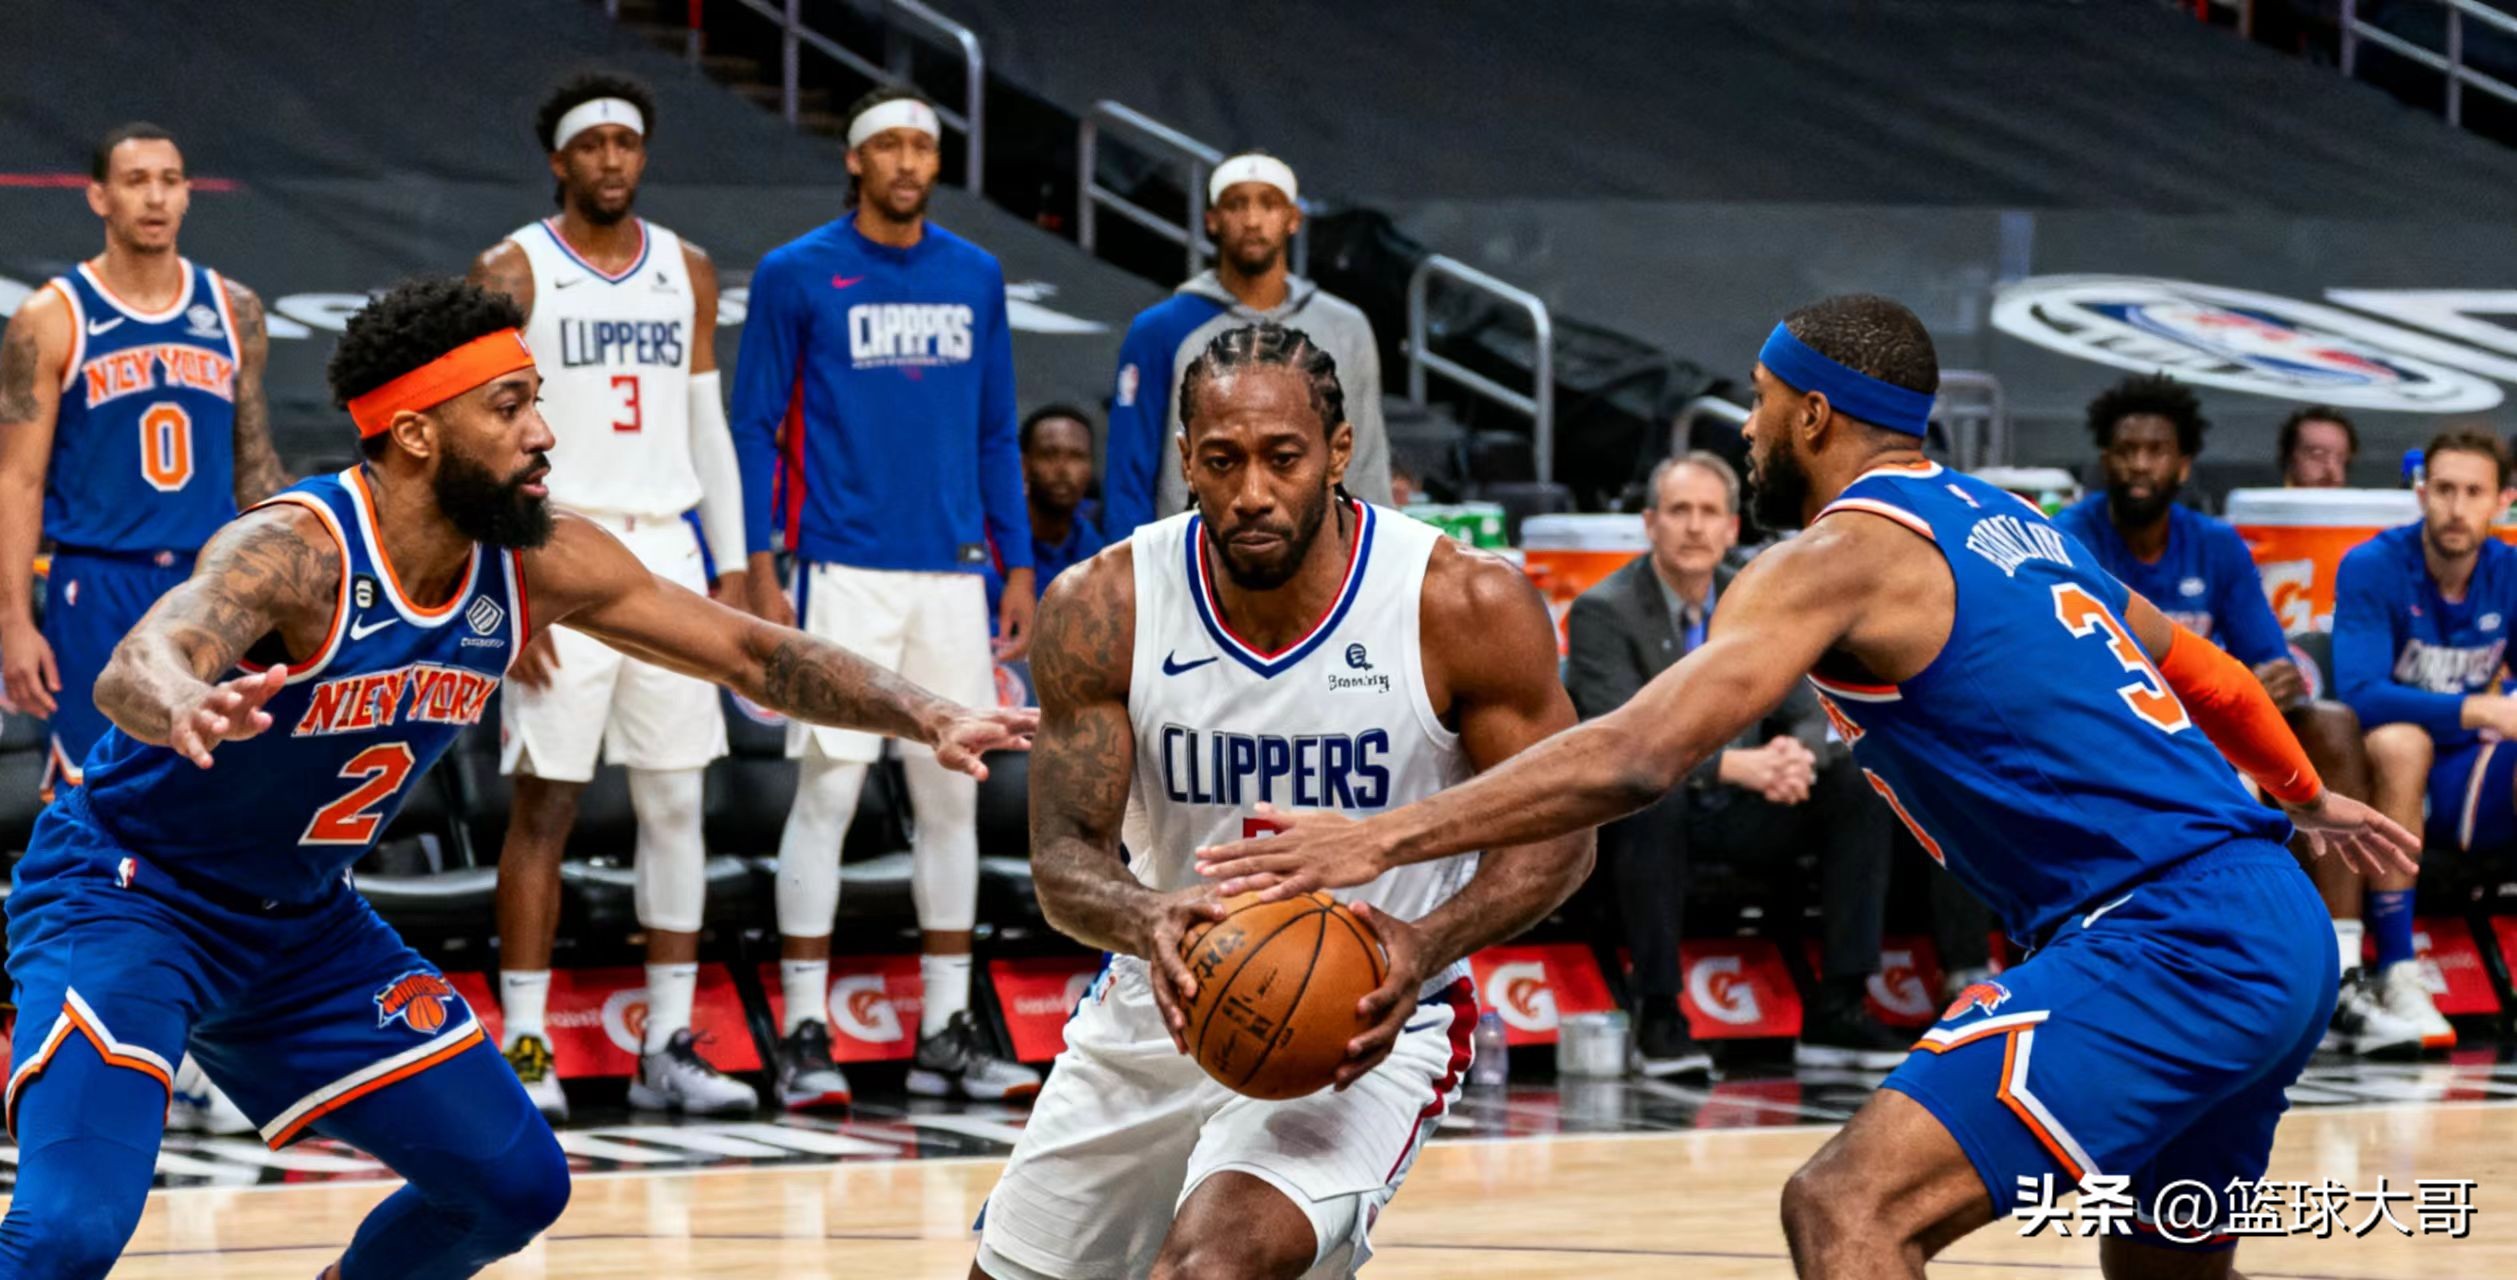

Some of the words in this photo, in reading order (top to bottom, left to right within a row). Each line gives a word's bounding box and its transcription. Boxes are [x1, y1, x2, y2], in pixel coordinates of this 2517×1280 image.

[610, 375, 642, 433] 3
[139, 402, 194, 492] 0
[2051, 582, 2192, 735] 3
[297, 741, 416, 846] 2
[1160, 721, 1391, 810] CLIPPERS
[829, 974, 904, 1042] G
[1486, 960, 1562, 1033] G
[1688, 956, 1764, 1026] G
